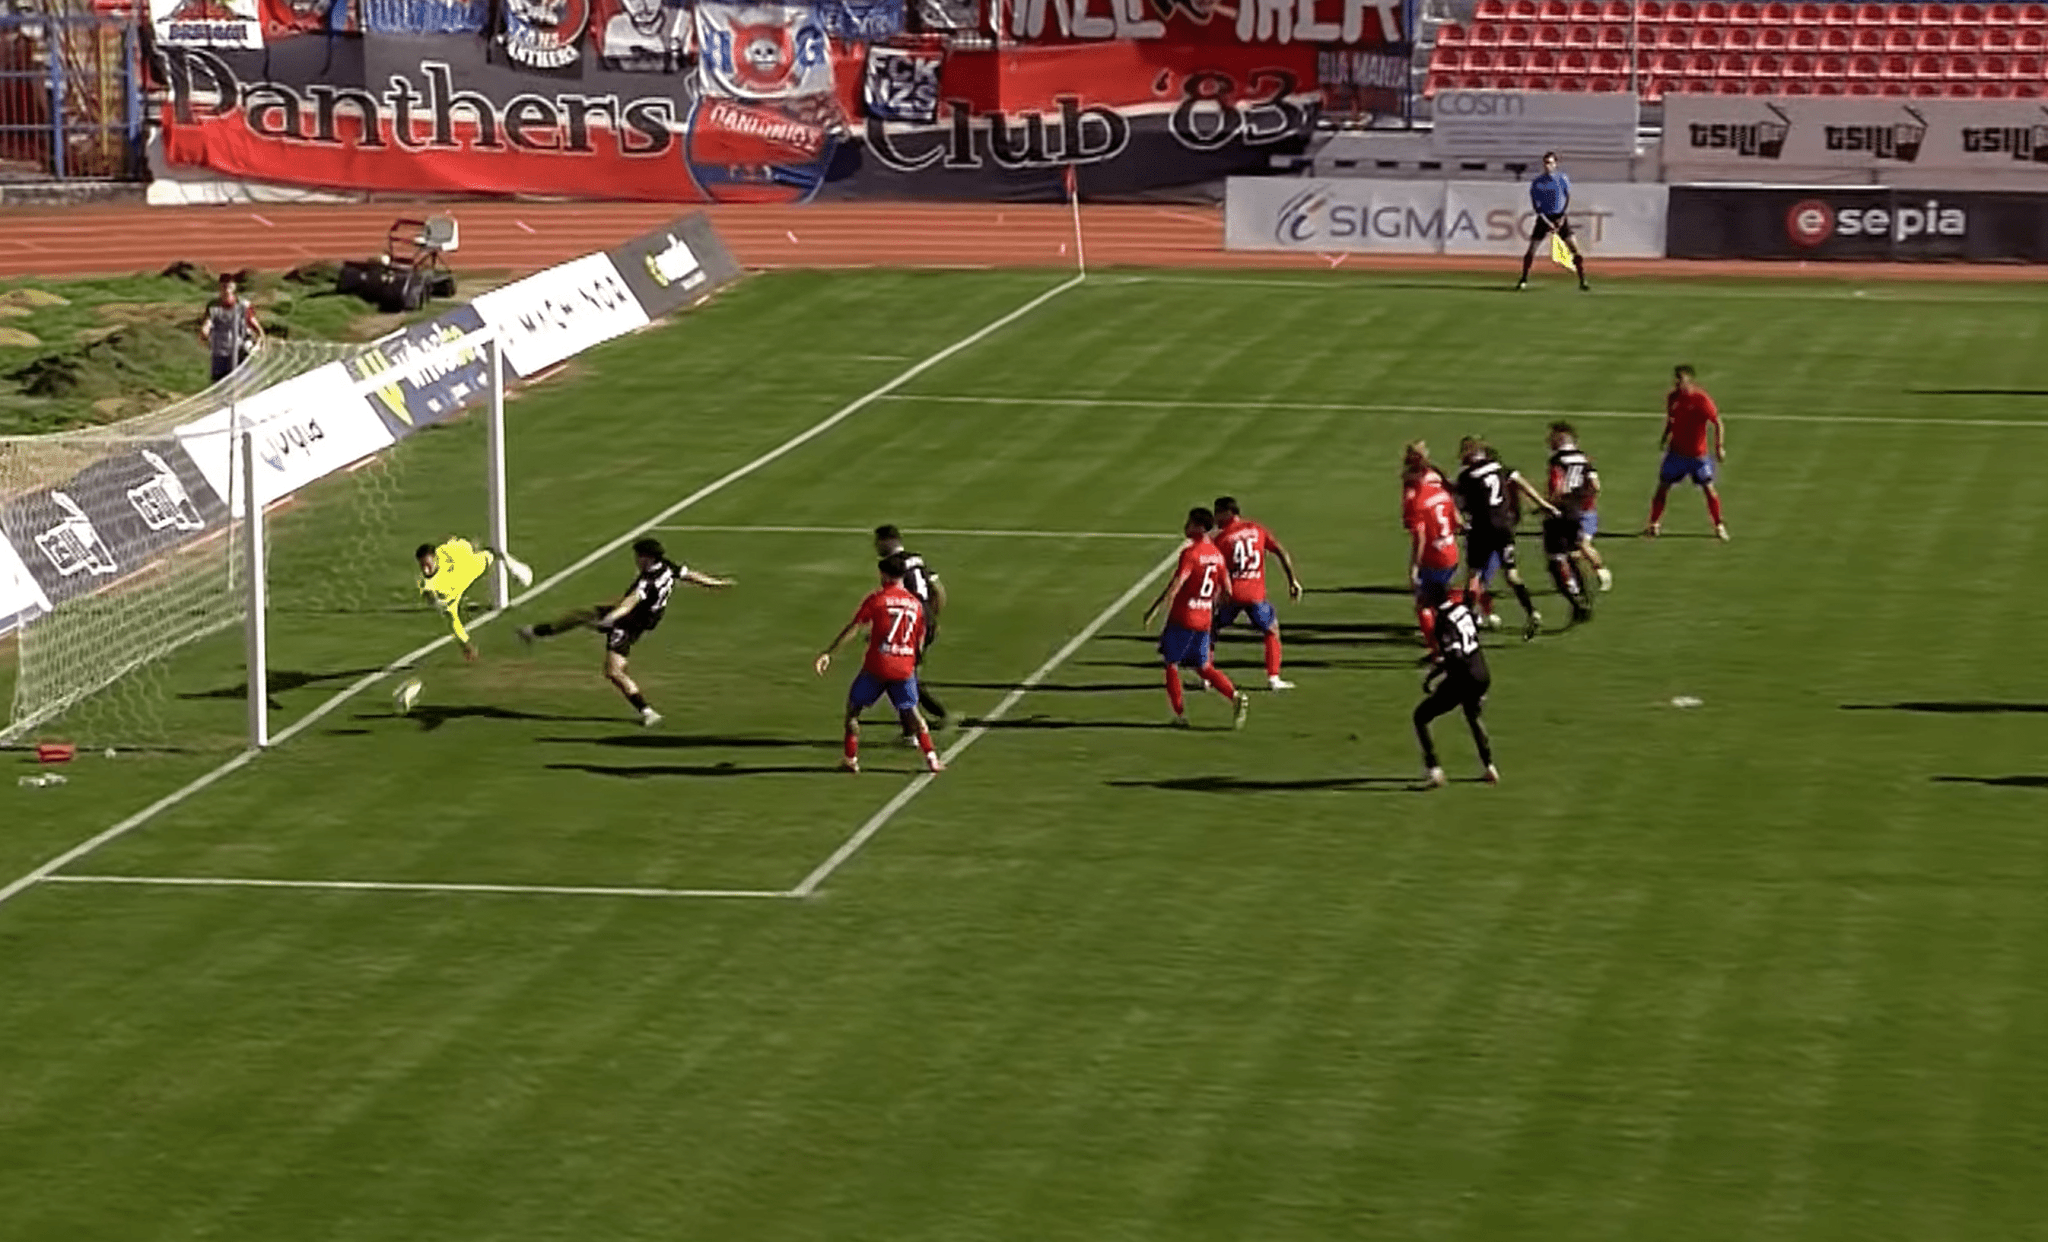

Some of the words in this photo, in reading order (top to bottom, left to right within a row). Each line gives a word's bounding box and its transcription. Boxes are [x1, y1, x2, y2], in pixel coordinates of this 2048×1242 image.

[153, 47, 674, 156] Panthers
[863, 92, 1130, 170] Club
[1836, 200, 1966, 242] sepia
[1484, 474, 1503, 506] 2
[1435, 504, 1450, 537] 5
[1234, 538, 1260, 570] 45
[1200, 565, 1217, 598] 6
[887, 607, 917, 643] 77
